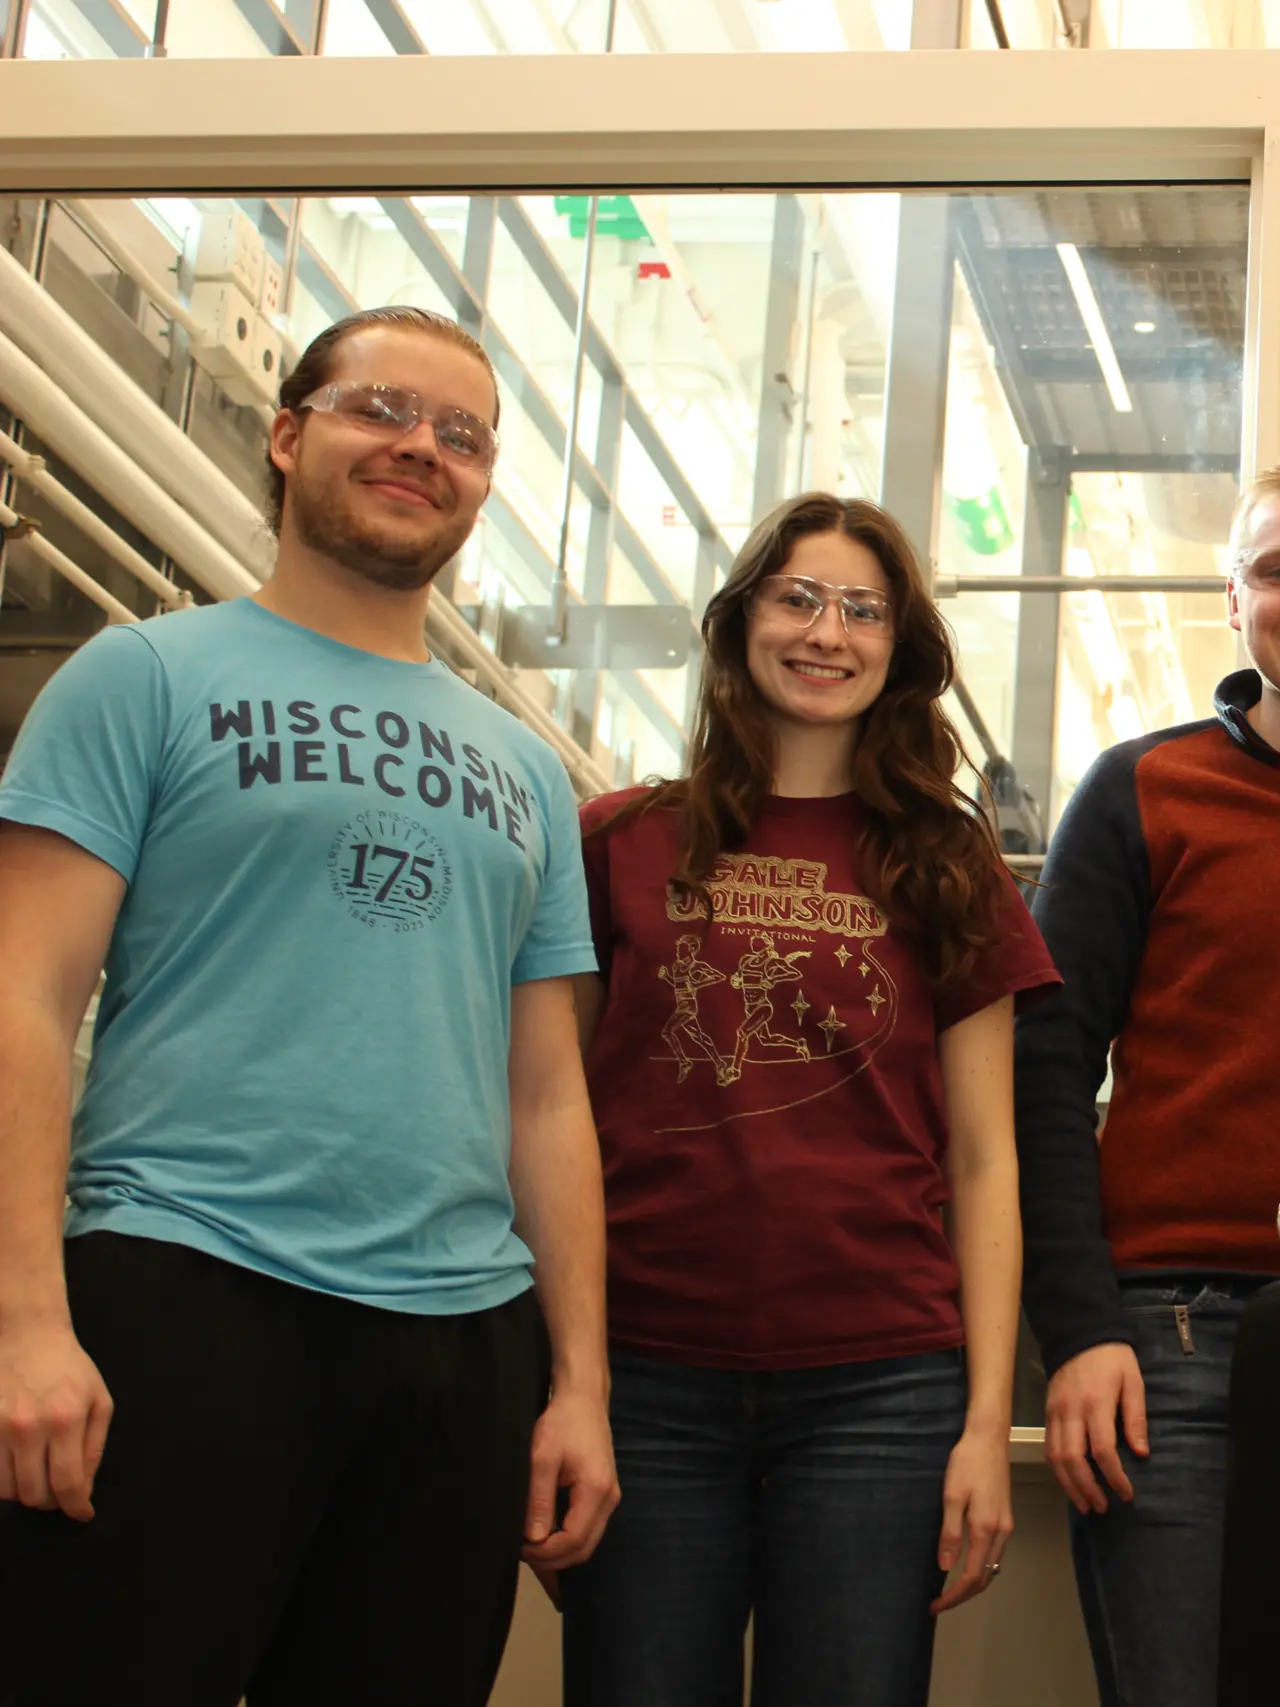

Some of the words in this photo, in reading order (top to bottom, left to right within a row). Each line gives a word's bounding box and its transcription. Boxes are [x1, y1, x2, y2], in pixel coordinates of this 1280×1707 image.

[209, 700, 532, 824] WISCONSIN
[238, 741, 526, 854] WELCOME
[327, 821, 353, 900] UNIVERSITY
[356, 809, 371, 823] OF
[344, 843, 435, 903] 175
[720, 926, 817, 943] INVITATIONAL
